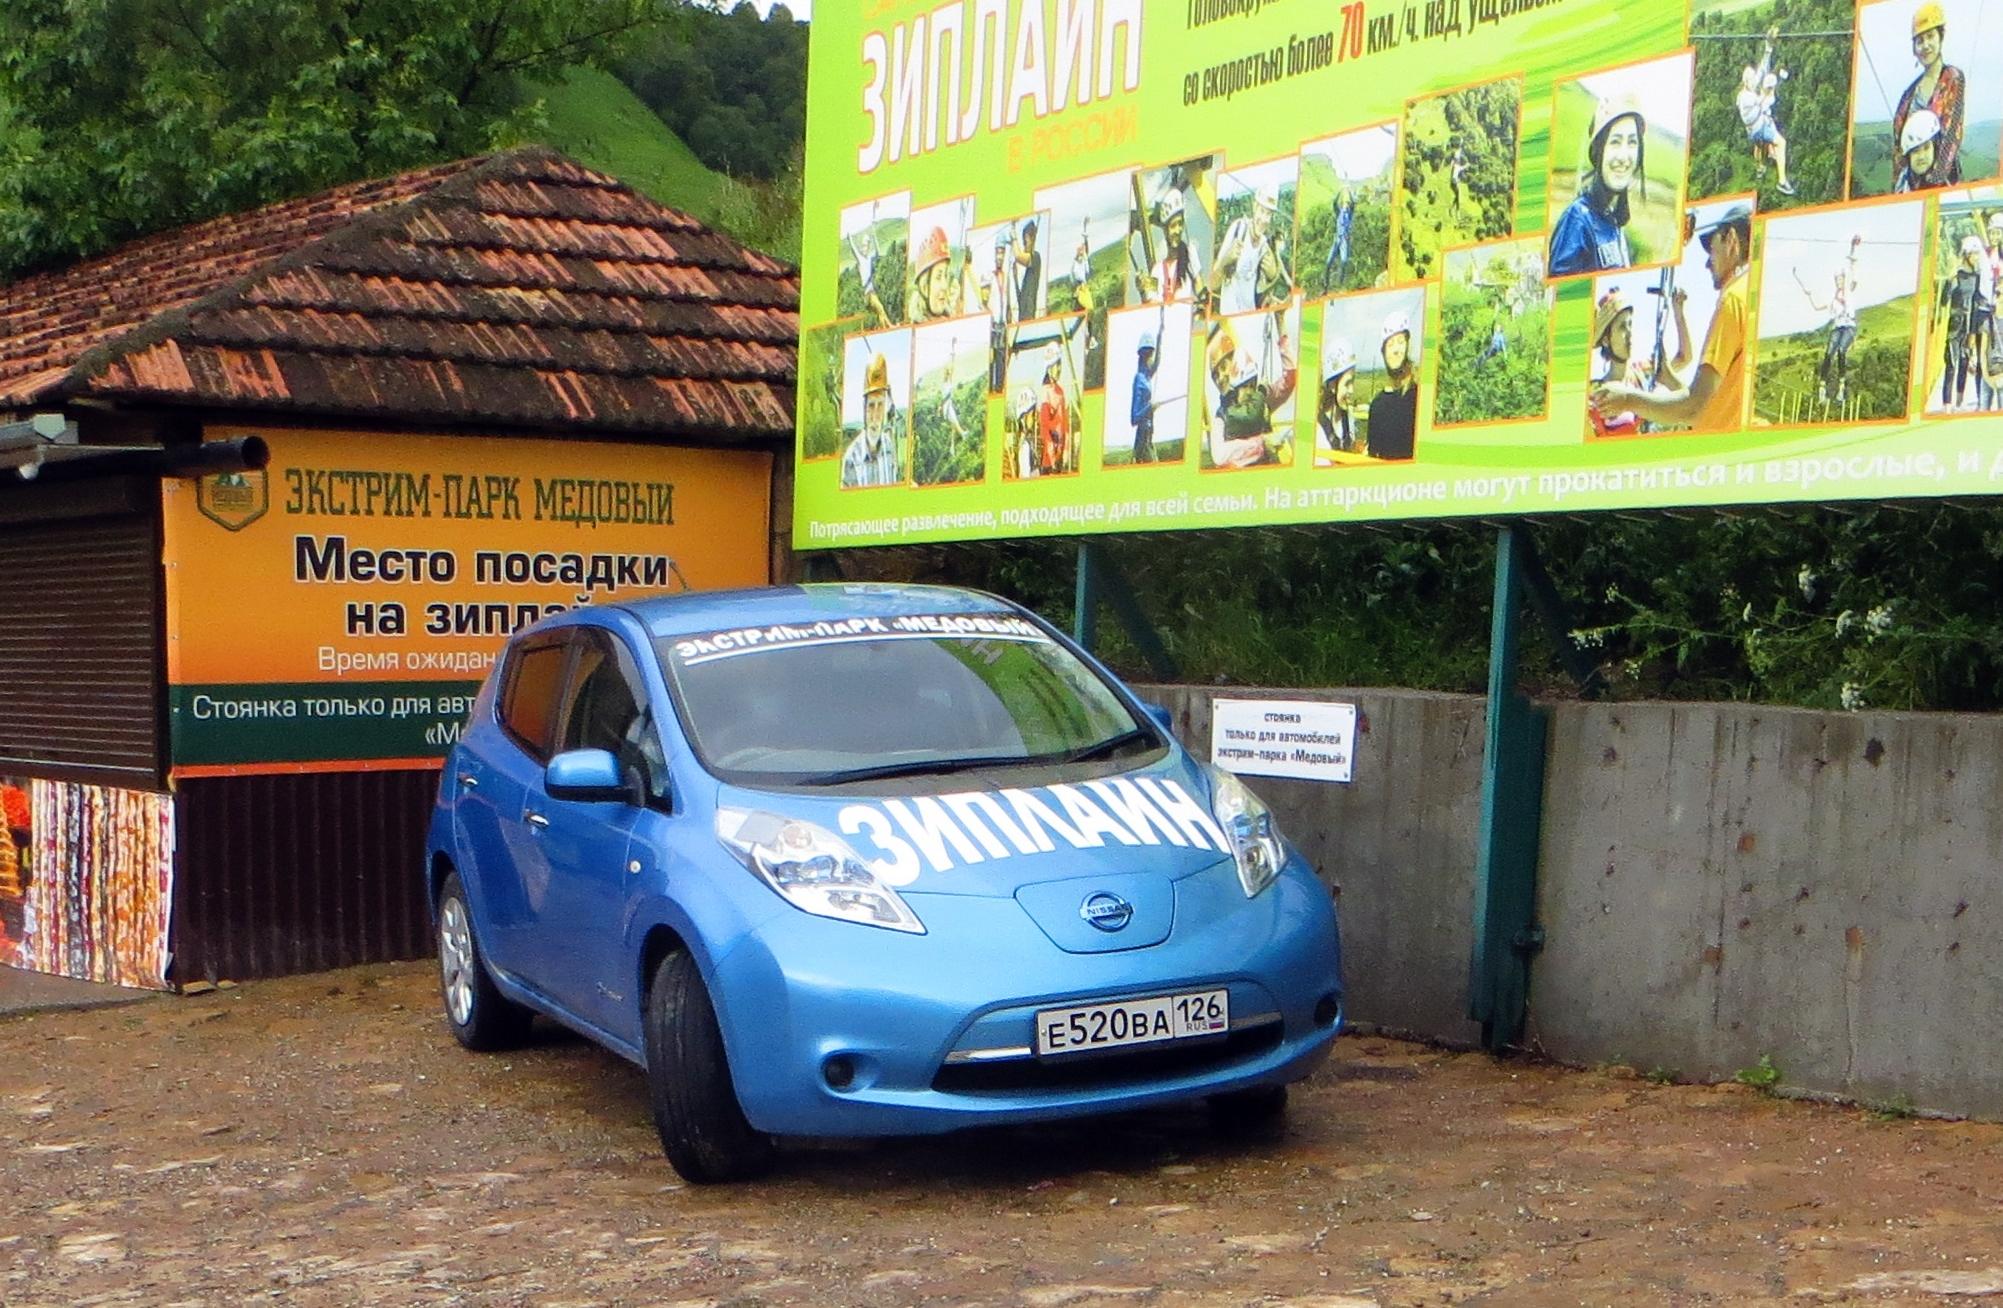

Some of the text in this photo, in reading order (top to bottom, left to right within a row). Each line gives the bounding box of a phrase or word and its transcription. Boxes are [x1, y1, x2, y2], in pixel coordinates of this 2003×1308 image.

[1183, 71, 1199, 106] со
[1203, 46, 1283, 101] скоростью
[1287, 31, 1333, 77] более
[1338, 1, 1365, 62] 70
[1424, 0, 1461, 41] над
[1006, 105, 1138, 174] В РОССИИ
[285, 468, 521, 520] ЭКСТРИМ-ПАРК
[810, 515, 898, 541] Потрясающее
[902, 507, 996, 536] развлечение,
[1001, 502, 1105, 530] подходящее
[1108, 498, 1141, 524] для
[1147, 491, 1188, 516] всей
[1194, 493, 1258, 514] семьи.
[1264, 486, 1290, 510] На
[1297, 479, 1446, 513] аттаркционе
[1454, 472, 1530, 505] могут
[1538, 463, 1725, 501] прокатиться
[1737, 462, 1755, 485] и
[1764, 450, 1945, 490] взрослые,
[1957, 449, 1981, 473] и
[295, 535, 669, 592] Место посадки
[346, 602, 407, 636] на
[318, 646, 496, 675] Время ожидан
[193, 695, 475, 720] Стоянка только для авт
[1264, 712, 1301, 724] стоянка
[1225, 729, 1341, 745] только для автомобилей
[1217, 748, 1346, 765] экстрим-парка «Медовый»
[1087, 902, 1131, 917] NISSAN
[1177, 994, 1222, 1024] 126
[1186, 1021, 1209, 1033] RUS
